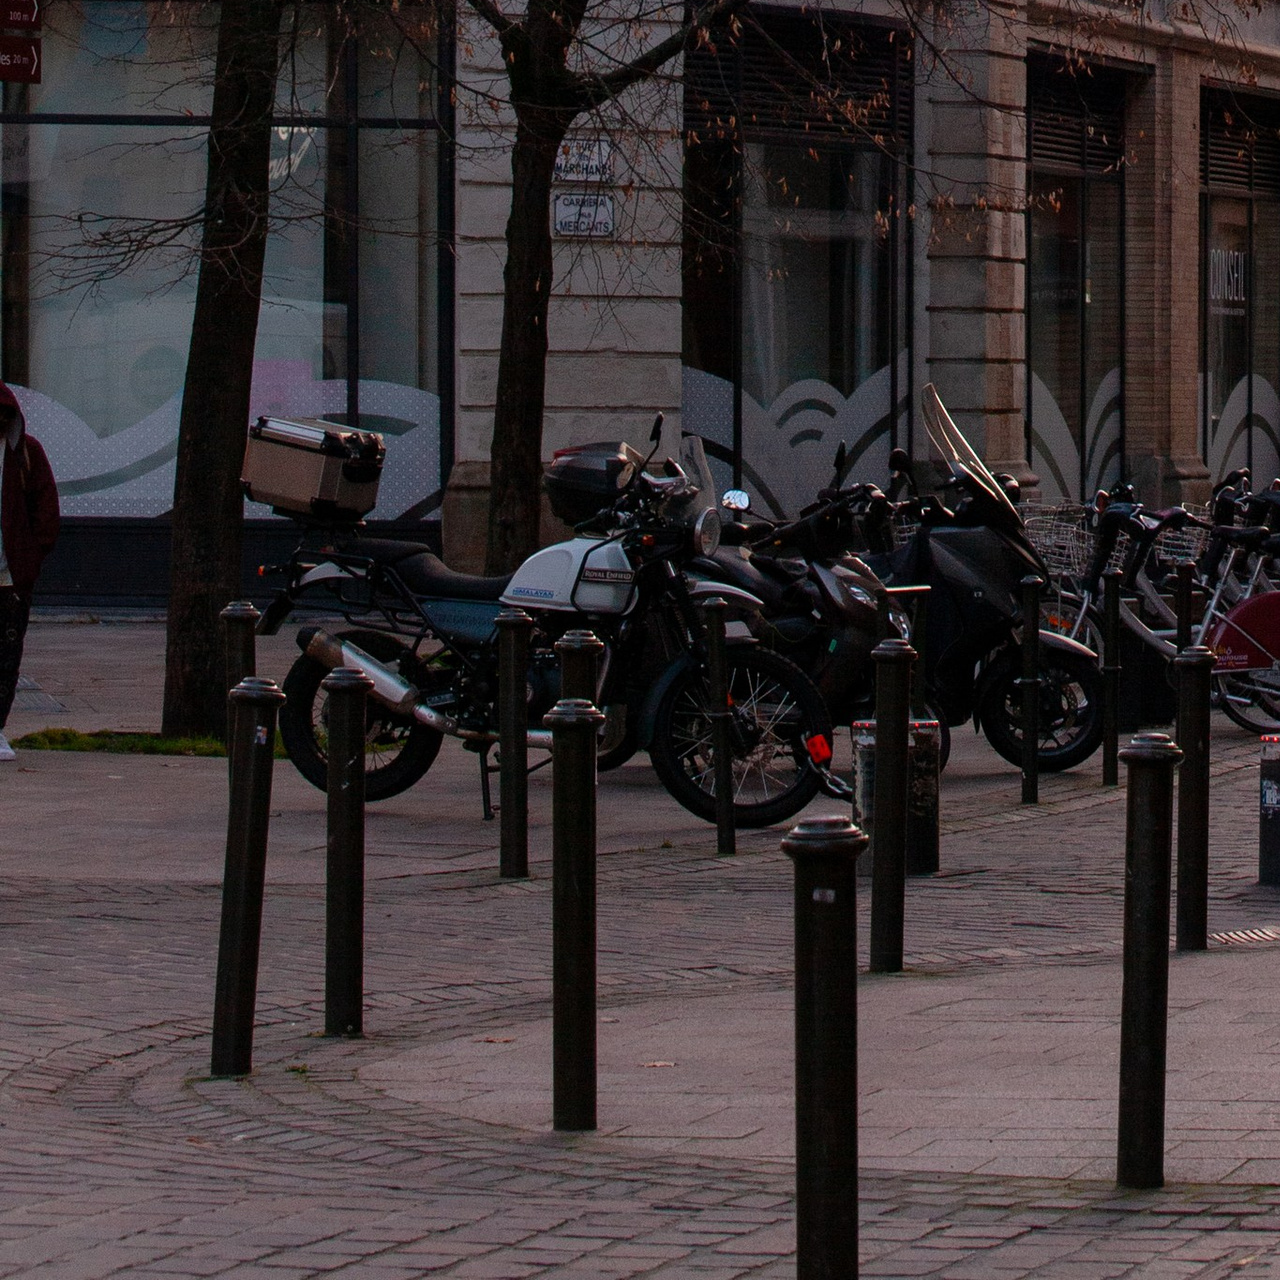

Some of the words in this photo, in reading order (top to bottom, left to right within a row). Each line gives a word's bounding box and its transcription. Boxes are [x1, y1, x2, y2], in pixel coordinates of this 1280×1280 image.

[9, 11, 22, 20] 100
[22, 13, 30, 21] m
[13, 54, 21, 64] 20
[22, 56, 30, 64] m
[560, 220, 610, 233] MERCANTS
[1210, 248, 1246, 301] CONSEIL
[584, 570, 605, 579] ROYAL
[606, 571, 632, 580] ENFIELD
[512, 588, 554, 599] HIMALAYAN
